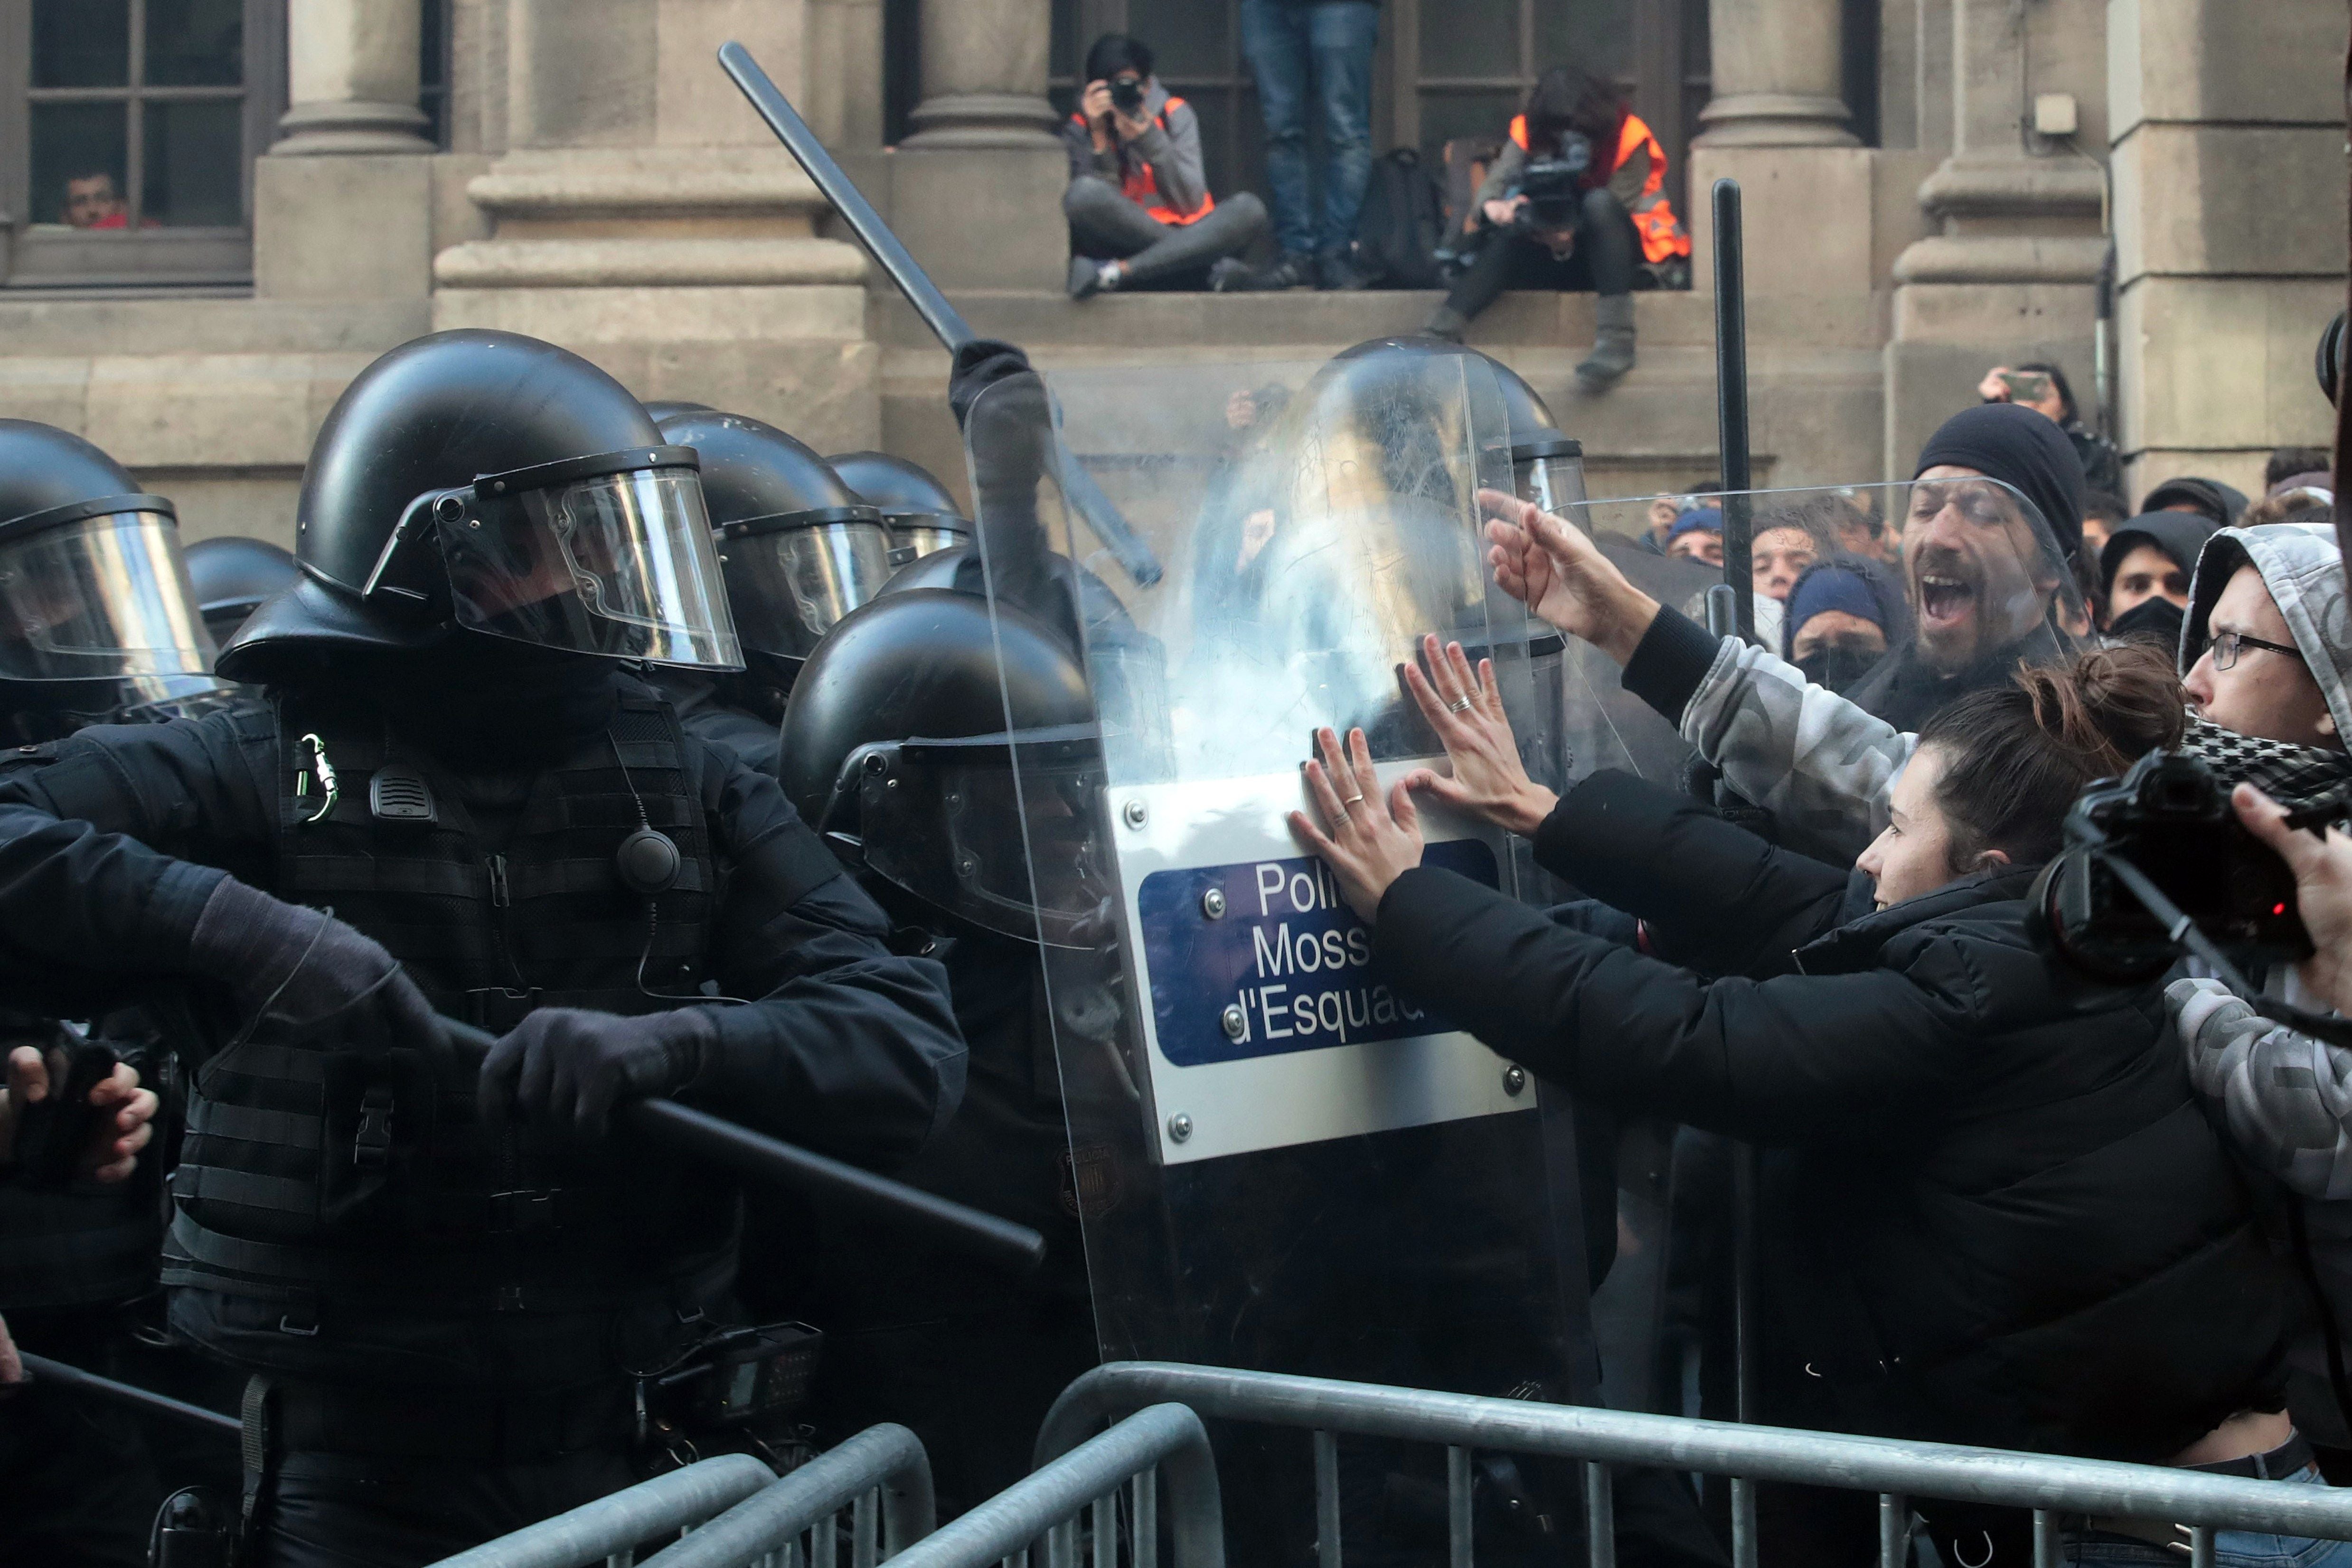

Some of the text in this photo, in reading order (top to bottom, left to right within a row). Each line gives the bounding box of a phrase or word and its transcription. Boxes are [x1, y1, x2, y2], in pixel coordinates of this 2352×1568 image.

[1256, 858, 1337, 917] Poli
[1252, 922, 1370, 978] Moss
[1225, 983, 1424, 1044] d'Esqua
